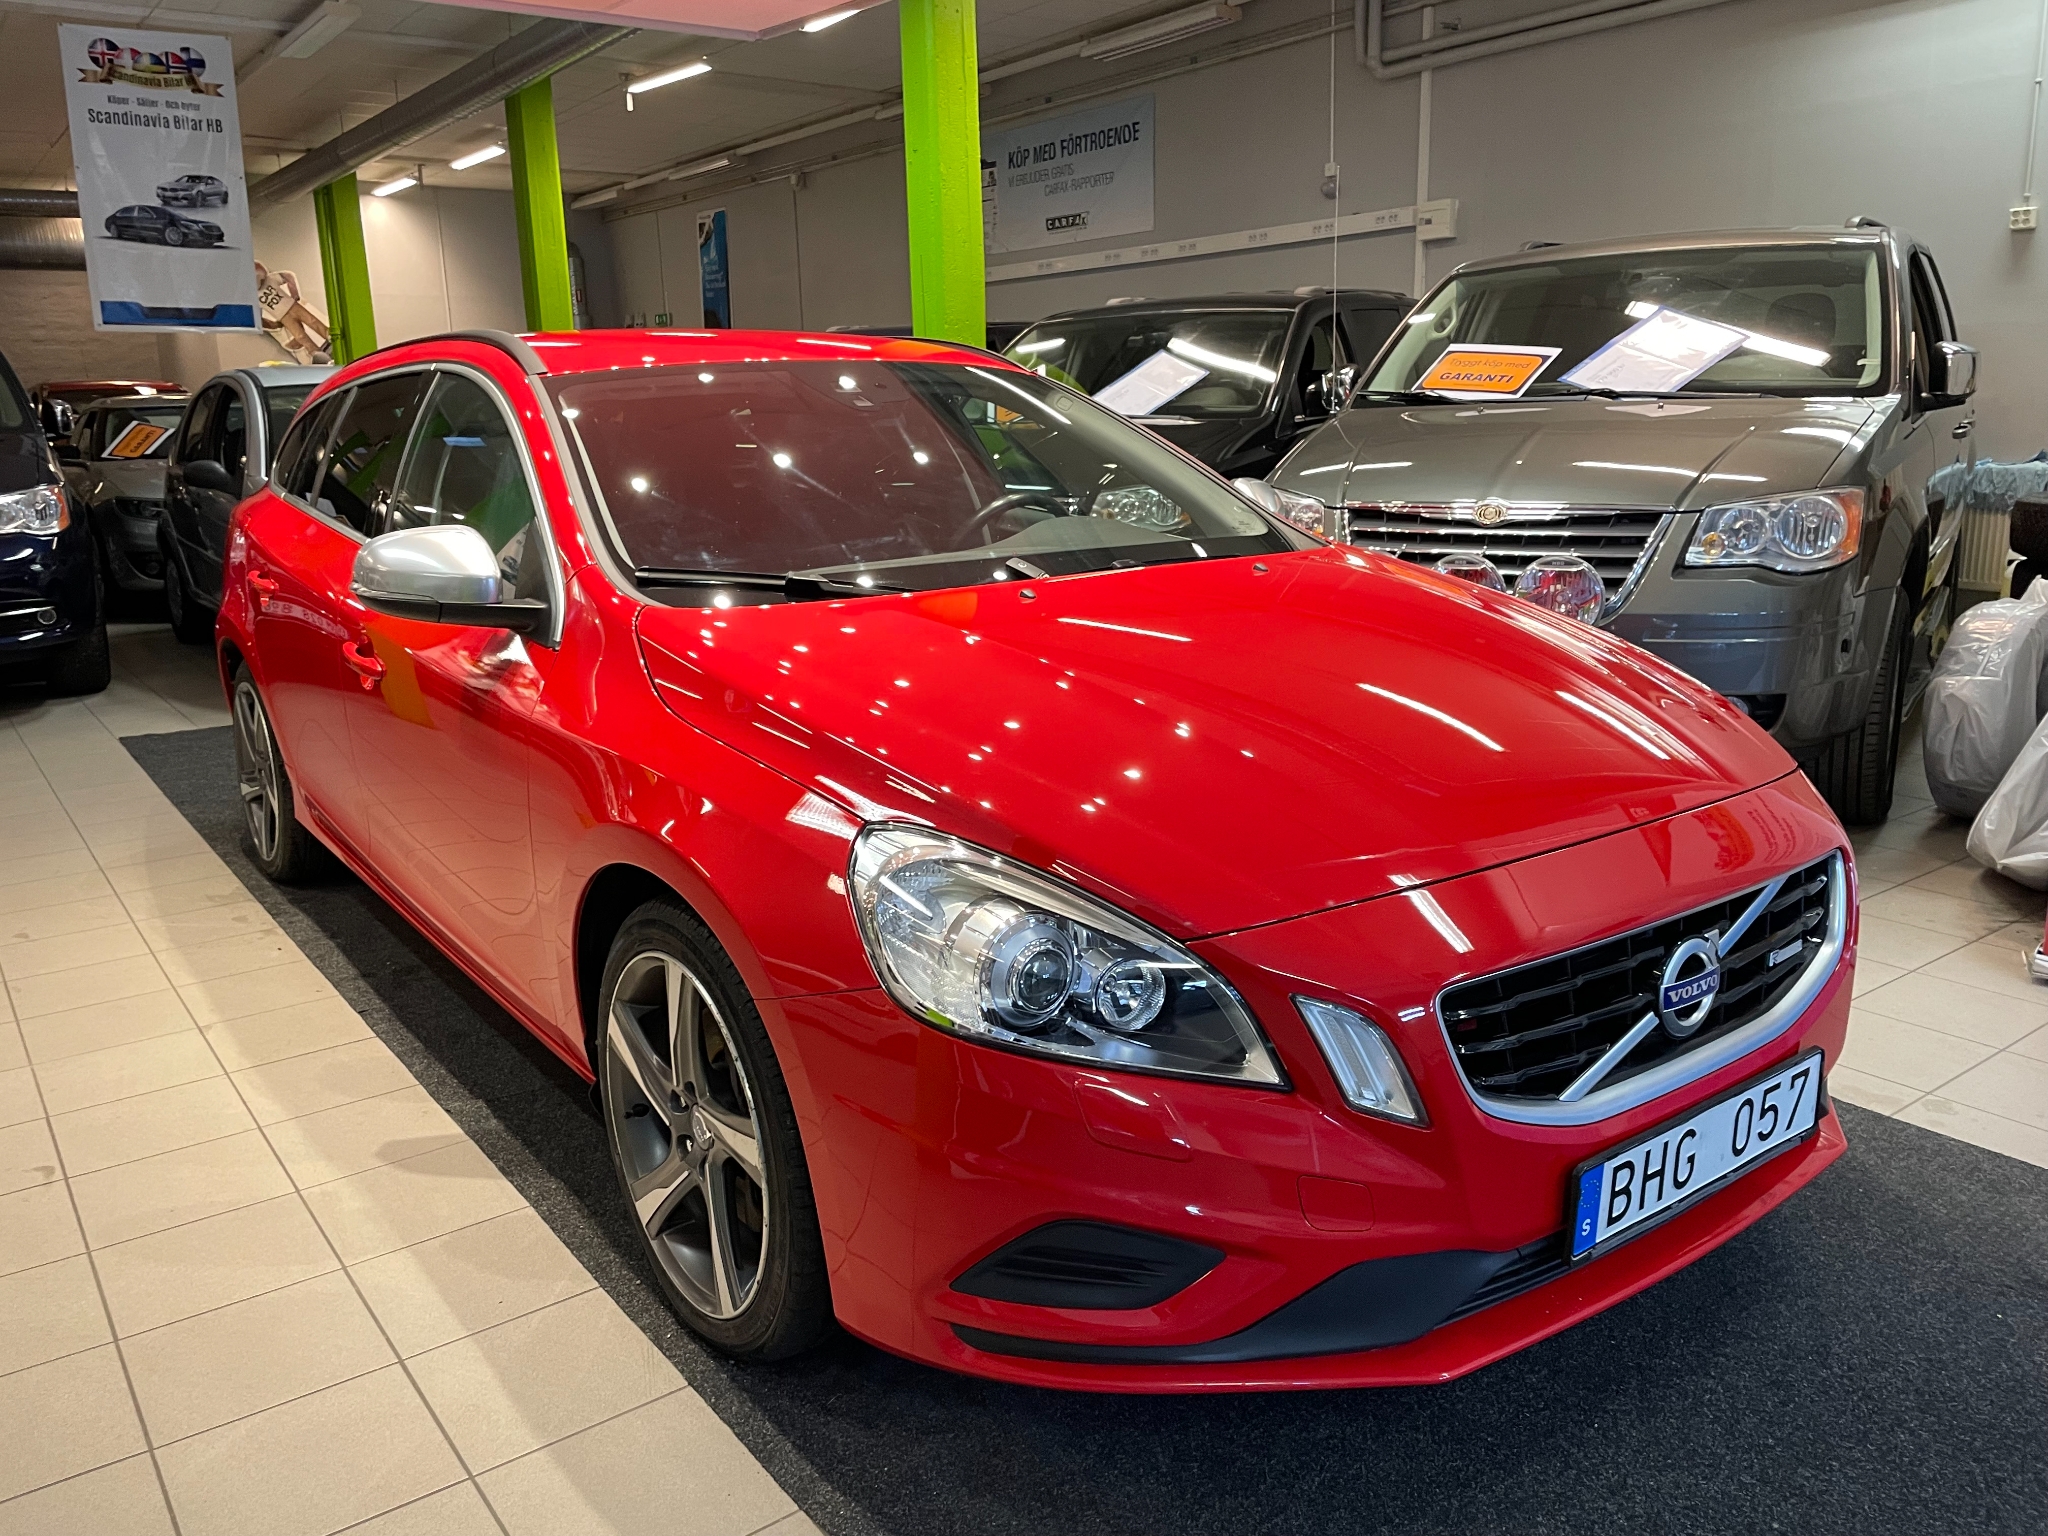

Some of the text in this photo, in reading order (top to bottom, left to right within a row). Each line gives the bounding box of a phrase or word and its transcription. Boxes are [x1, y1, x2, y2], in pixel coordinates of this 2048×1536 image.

[87, 107, 224, 134] Scandinavia Bilar HB
[1007, 121, 1141, 170] KÖP MED FÖRTROENDE
[1046, 213, 1088, 231] CARFAX
[259, 285, 276, 304] CAR
[267, 292, 284, 310] FOX
[1483, 358, 1502, 369] köp
[1504, 361, 1533, 370] med
[1440, 372, 1515, 383] GARANTI
[1667, 974, 1718, 1003] VOLVO
[1581, 1067, 1811, 1237] S BHG 057
